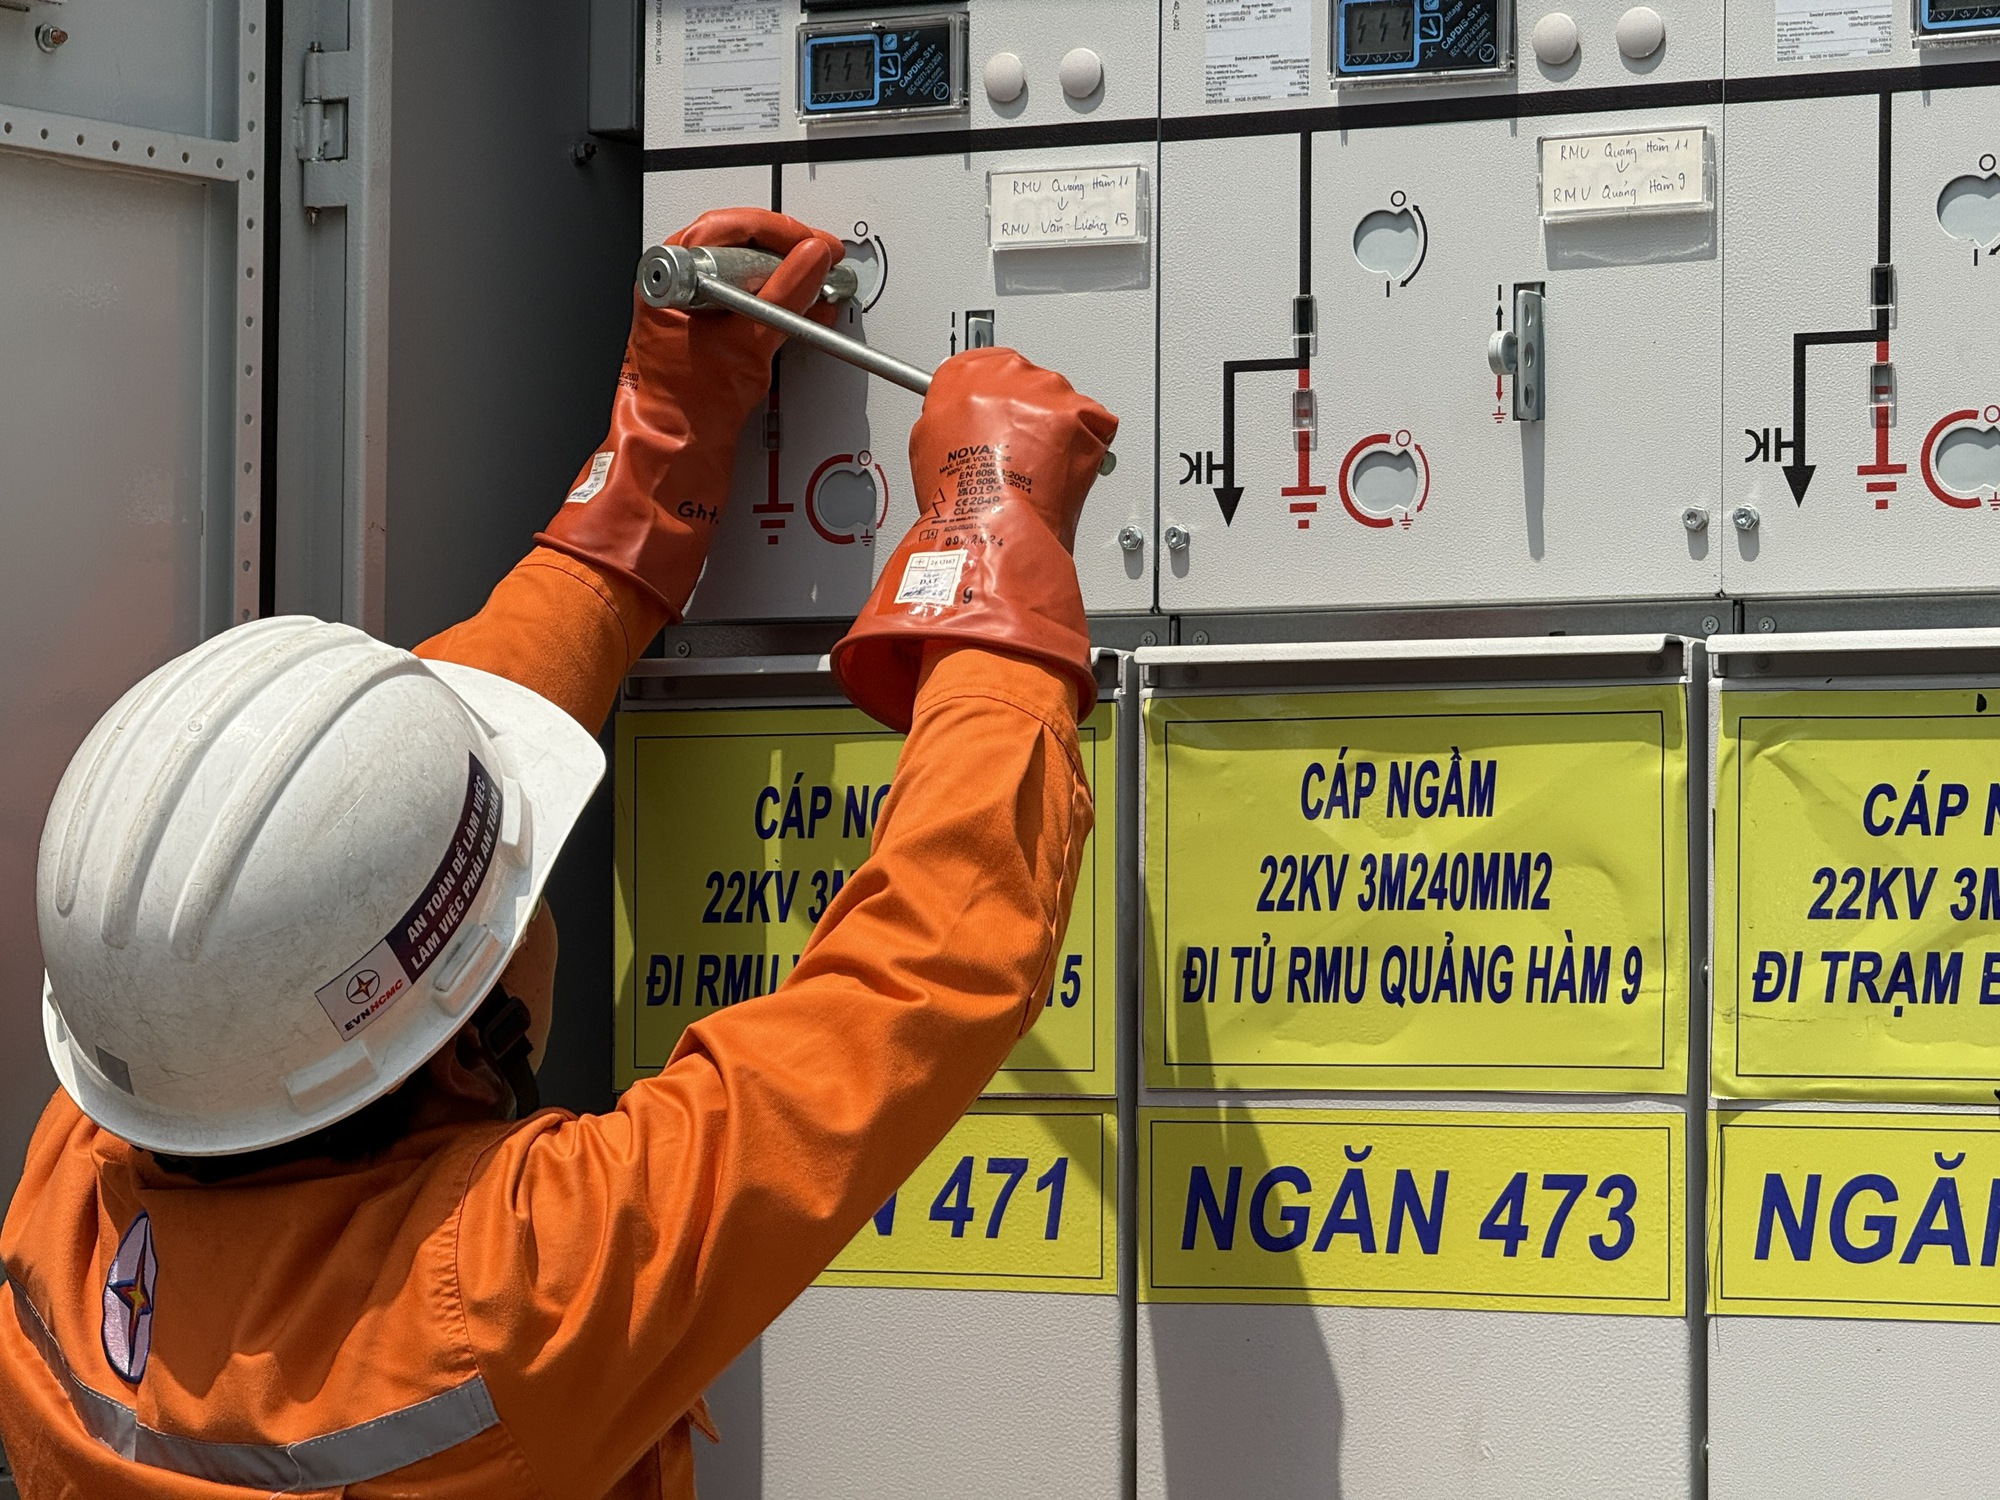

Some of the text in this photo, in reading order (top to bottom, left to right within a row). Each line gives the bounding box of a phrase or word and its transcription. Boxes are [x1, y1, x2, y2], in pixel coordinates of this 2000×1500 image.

[1441, 3, 1482, 49] CAPDIS-S1+
[1561, 145, 1590, 161] RMU
[1013, 180, 1042, 195] RMU
[1554, 186, 1592, 203] RMU
[1649, 175, 1674, 194] Hàm
[1678, 172, 1686, 190] 9
[1002, 223, 1030, 236] RMU
[957, 479, 974, 488] IEC
[959, 470, 974, 480] EN
[754, 771, 833, 840] CÁP
[1300, 746, 1497, 820] CÁP NGẦM
[1862, 769, 1969, 836] CÁP
[406, 913, 428, 943] AN
[425, 871, 454, 918] TOÀN
[465, 812, 481, 852] LÀM
[473, 774, 487, 813] VIỆC
[1256, 851, 1552, 912] 22KV 3M240MM2
[410, 934, 441, 970] LÀM
[438, 898, 466, 935] VIỆC
[463, 857, 485, 901] PHẢI
[483, 832, 494, 859] AN
[702, 870, 799, 924] 22KV
[1806, 867, 1939, 921] 22KV
[646, 954, 685, 1007] ĐI
[694, 954, 779, 1007] RMU
[1182, 929, 1643, 1008] ĐI TỦ RMU QUẢNG HÀM 9
[1752, 951, 1803, 1003] ĐI
[1820, 951, 1964, 1018] TRẠM
[344, 979, 404, 1032] EVNHCMC
[929, 1156, 1069, 1240] 471
[1181, 1145, 1638, 1261] NGĂN 473
